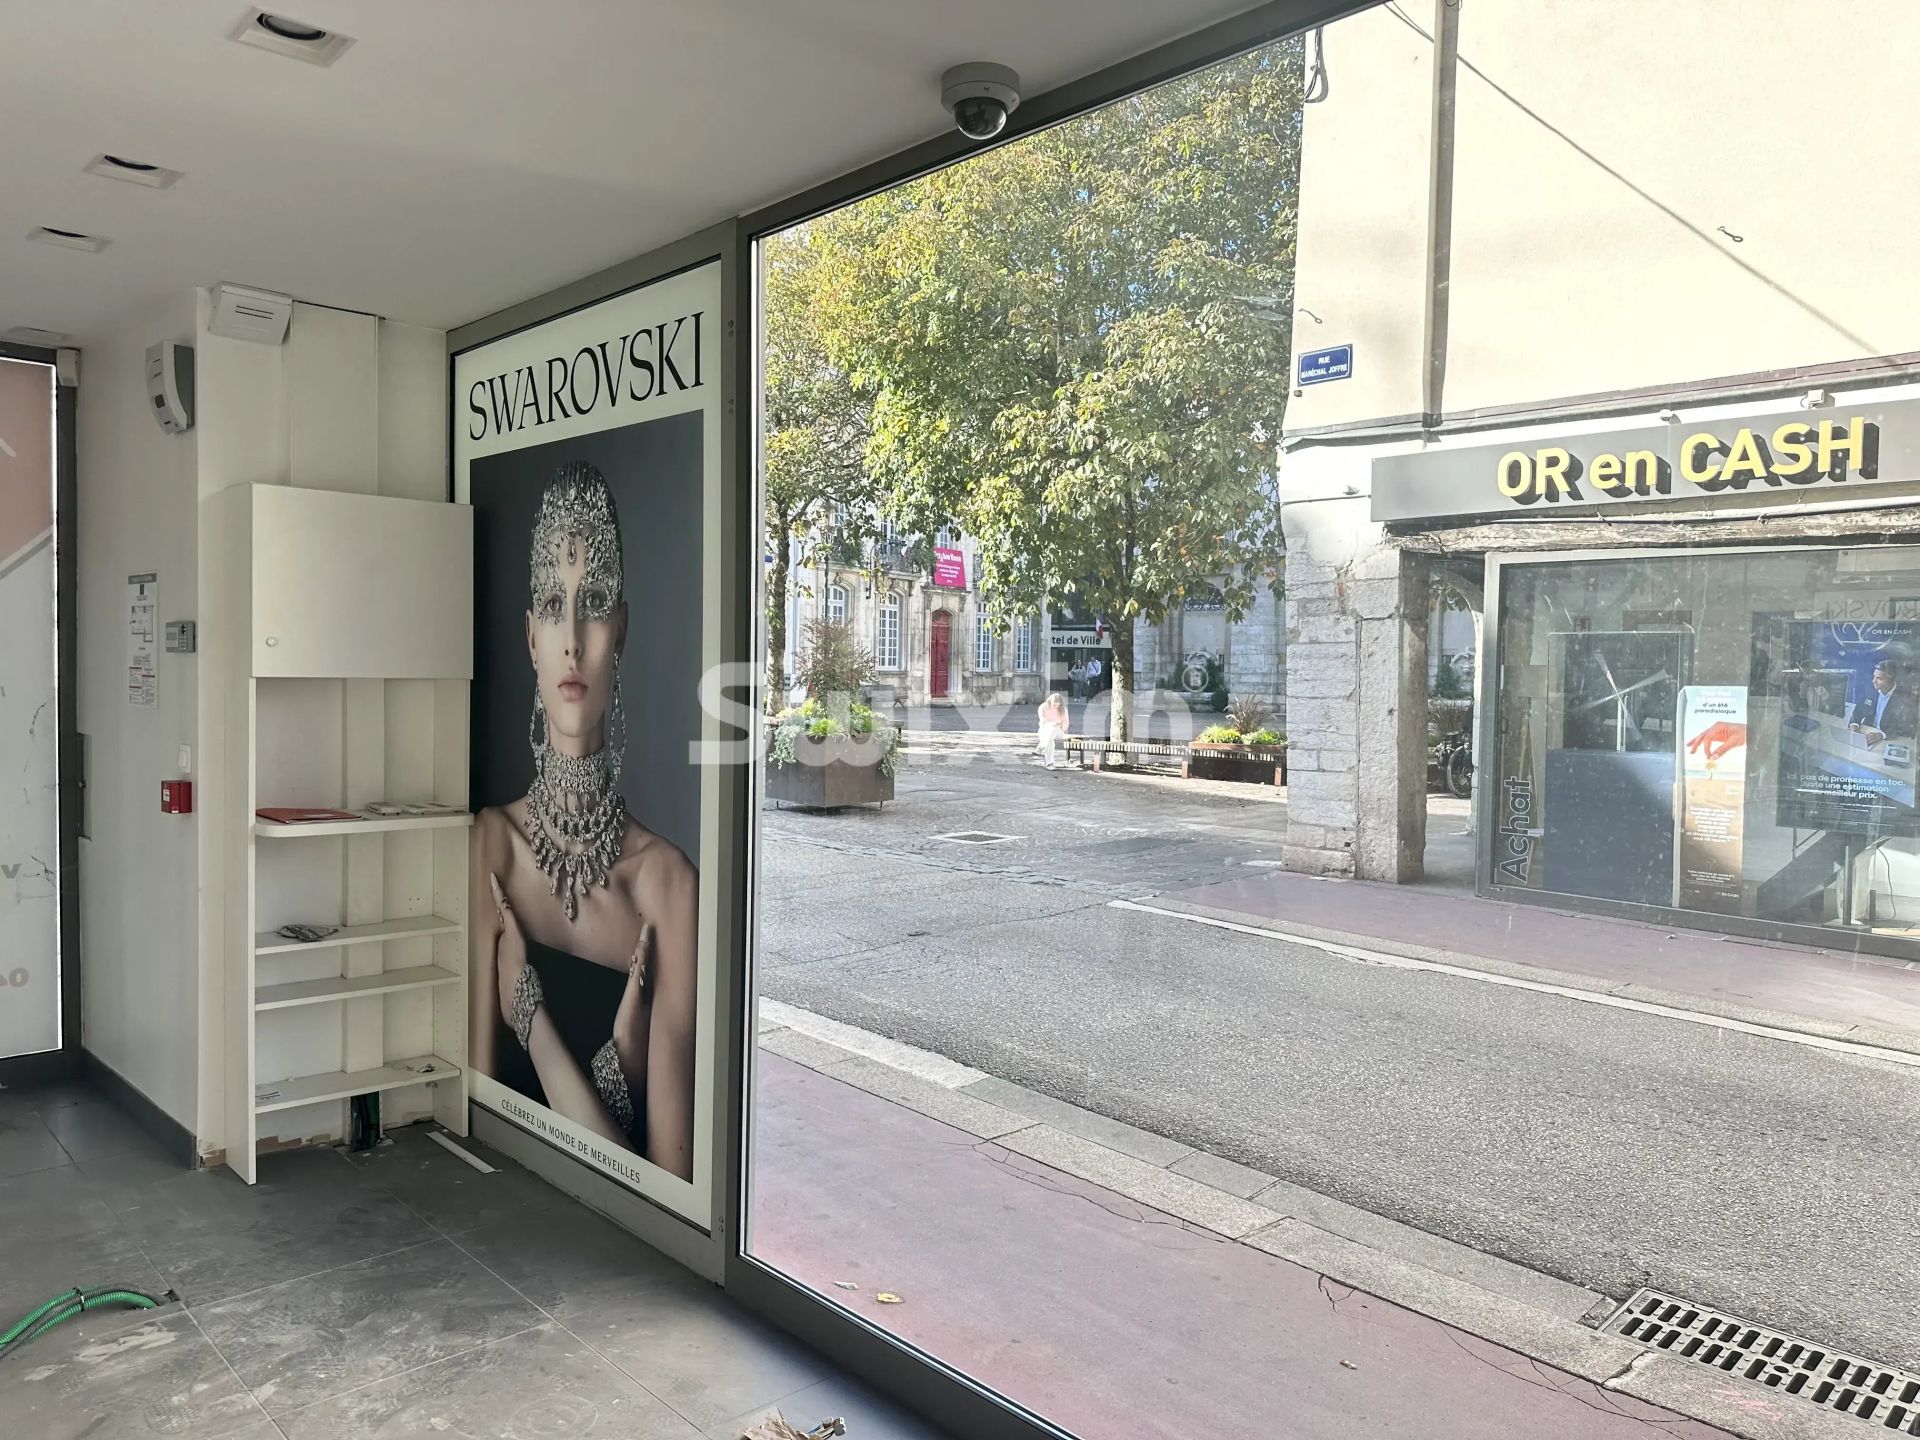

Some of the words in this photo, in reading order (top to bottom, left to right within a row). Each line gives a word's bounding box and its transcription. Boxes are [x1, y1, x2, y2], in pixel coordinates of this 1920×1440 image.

[1318, 356, 1330, 365] RUE
[469, 311, 704, 441] SWAROVSKI
[1301, 367, 1327, 378] MARÉCHAL
[1328, 364, 1347, 373] JOFFRE
[1497, 446, 1575, 500] OR
[1589, 449, 1660, 492] en
[1680, 416, 1870, 485] CASH
[1052, 636, 1064, 645] tel
[1066, 636, 1078, 645] de
[1080, 636, 1101, 645] Ville
[1800, 774, 1816, 782] pas
[1831, 775, 1874, 785] promesse
[1842, 782, 1889, 793] estimation
[1859, 791, 1878, 799] prix.
[1499, 775, 1531, 884] Achat
[501, 1099, 535, 1126] CÉLÉBREZ
[536, 1117, 547, 1132] UN
[549, 1124, 576, 1148] MONDE
[578, 1140, 589, 1155] DE
[590, 1147, 641, 1184] MERVEILLES
